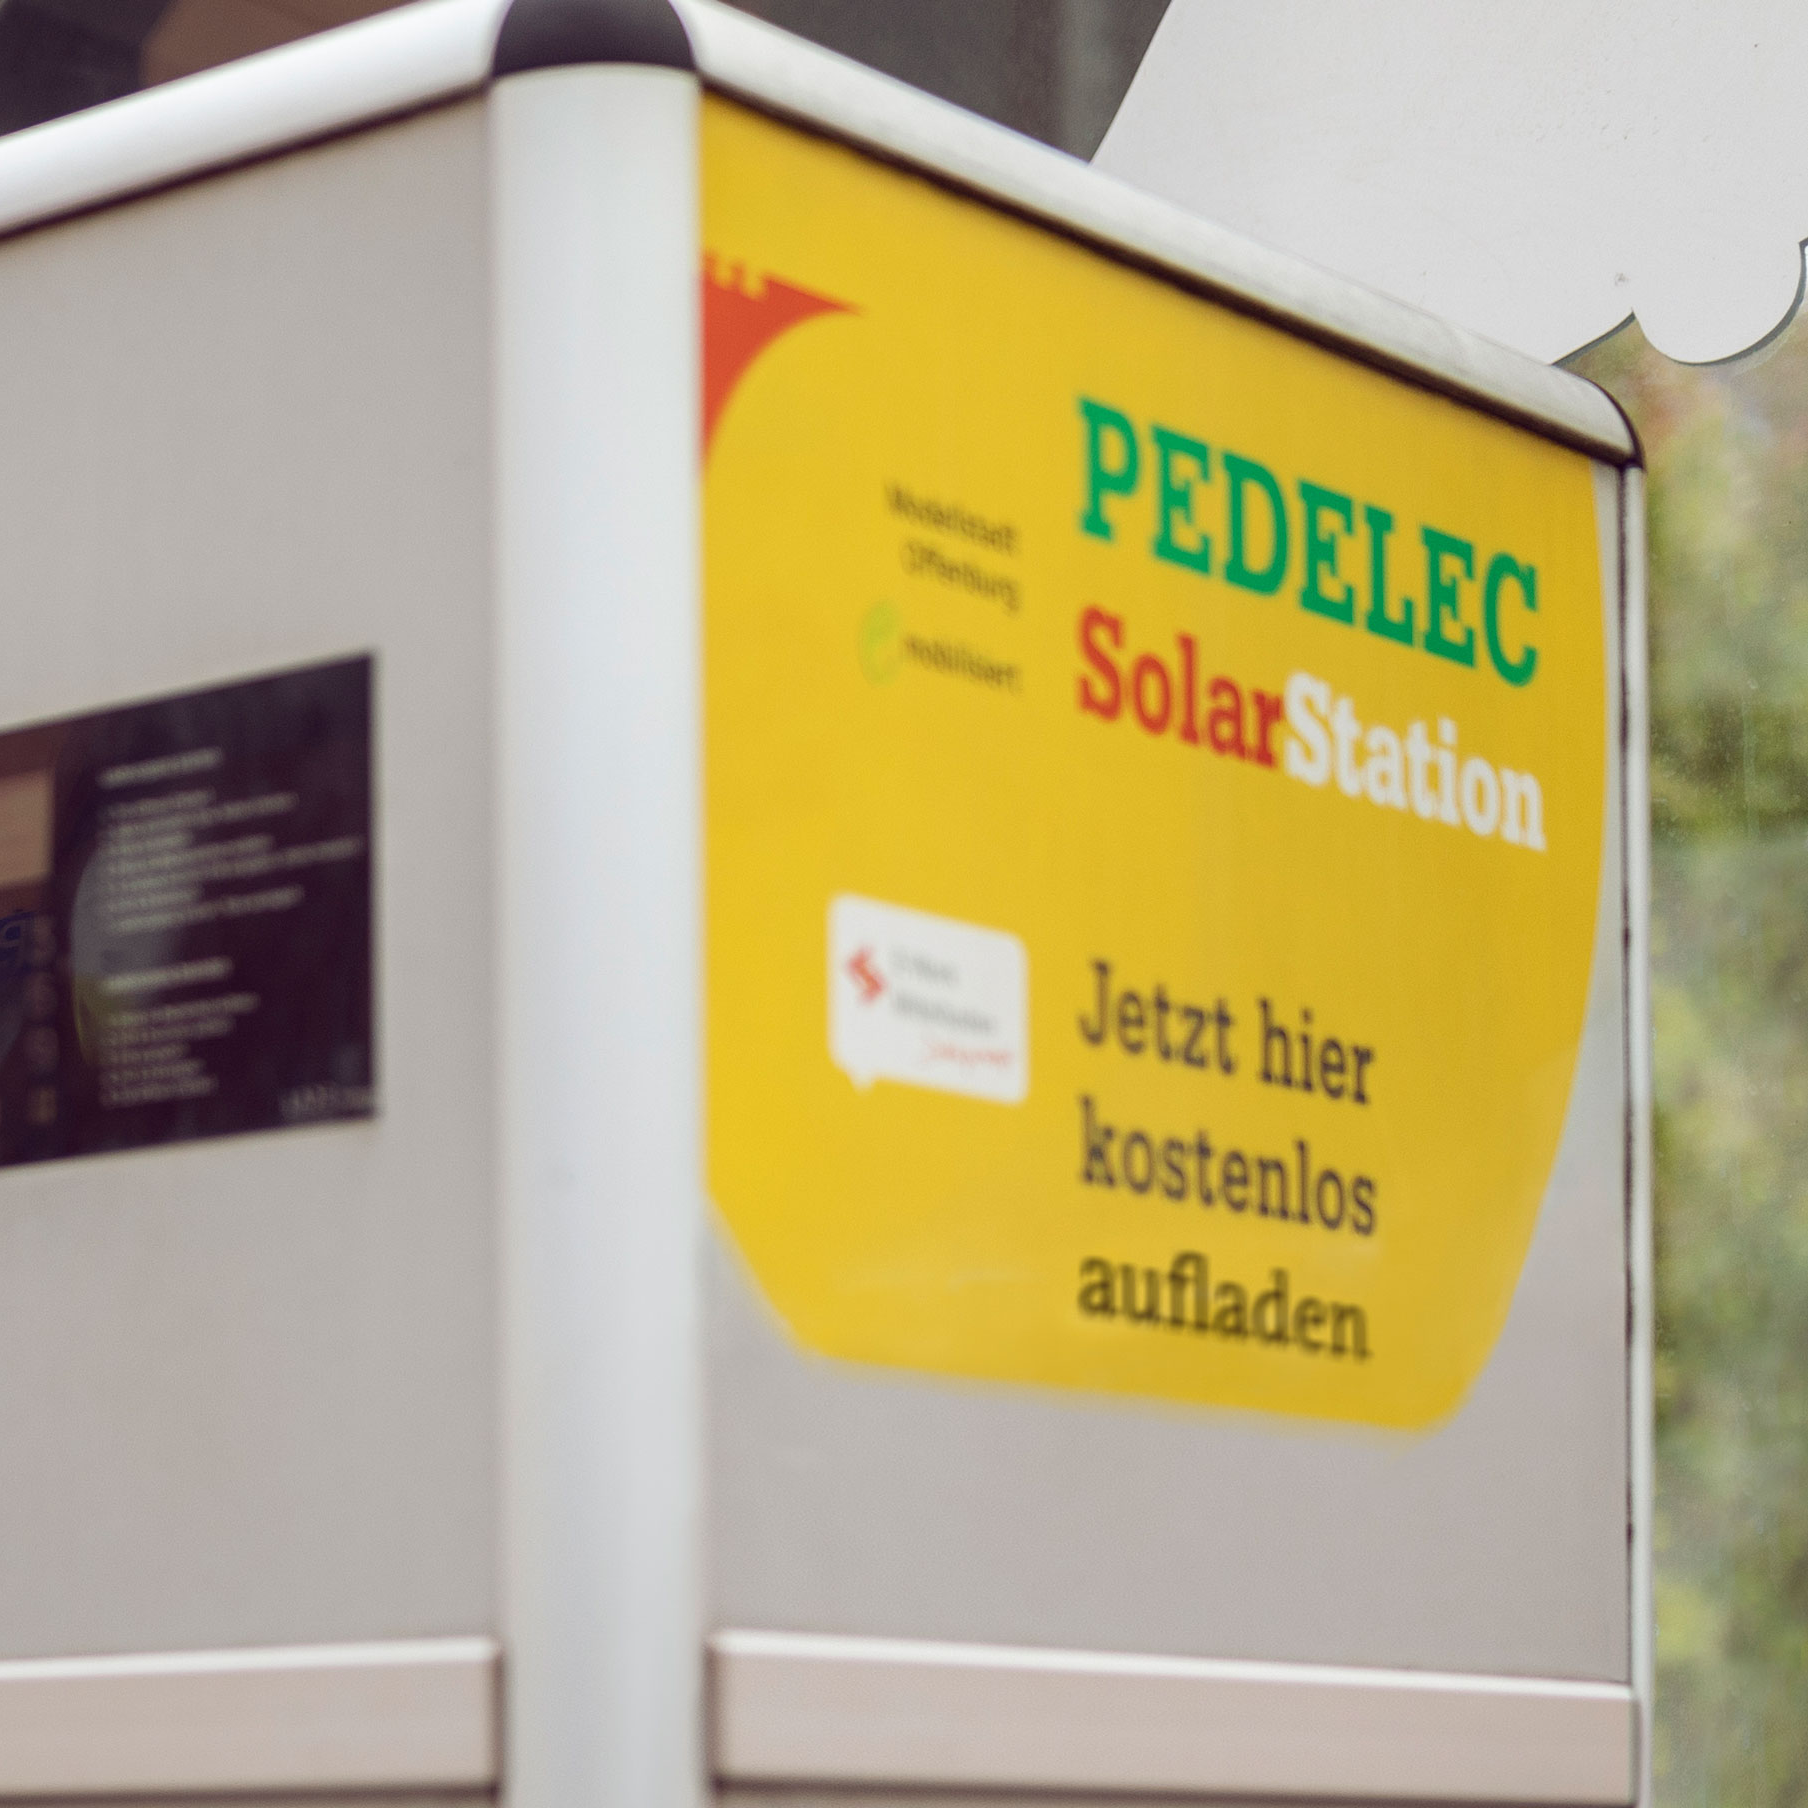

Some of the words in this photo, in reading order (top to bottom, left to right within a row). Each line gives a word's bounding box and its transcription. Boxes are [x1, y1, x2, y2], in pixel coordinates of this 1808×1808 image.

[1076, 395, 1540, 688] PEDELEC
[1076, 605, 1546, 852] SolarStation
[1079, 958, 1235, 1076] Jetzt
[1256, 995, 1376, 1105] hier
[1080, 1094, 1377, 1237] kostenlos
[1077, 1250, 1373, 1363] aufladen
